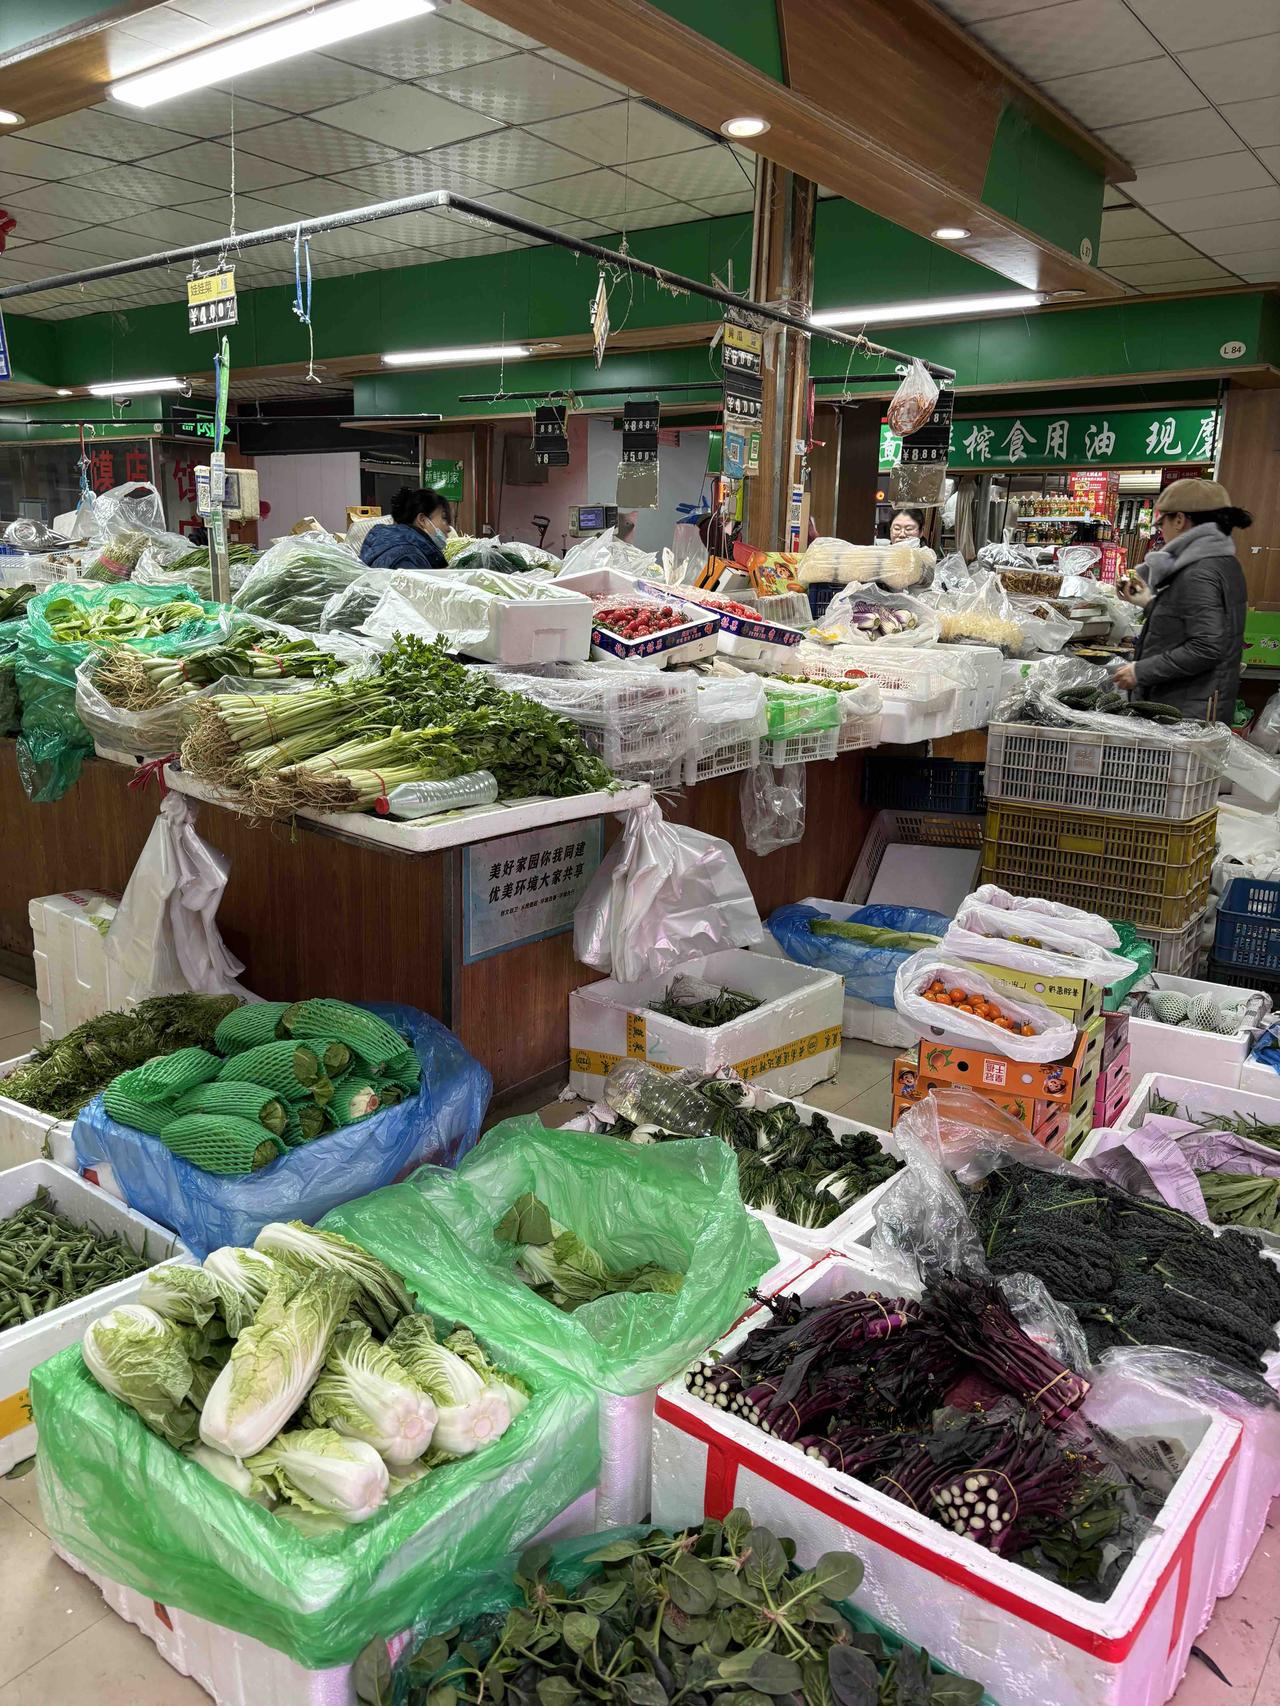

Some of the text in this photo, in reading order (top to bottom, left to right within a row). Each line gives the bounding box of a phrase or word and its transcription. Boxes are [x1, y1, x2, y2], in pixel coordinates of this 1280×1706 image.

[190, 281, 213, 297] 娃娃菜
[1231, 345, 1242, 354] 84
[488, 841, 586, 881] 美好家园你我同建
[488, 863, 584, 904] 优美环境大家共享
